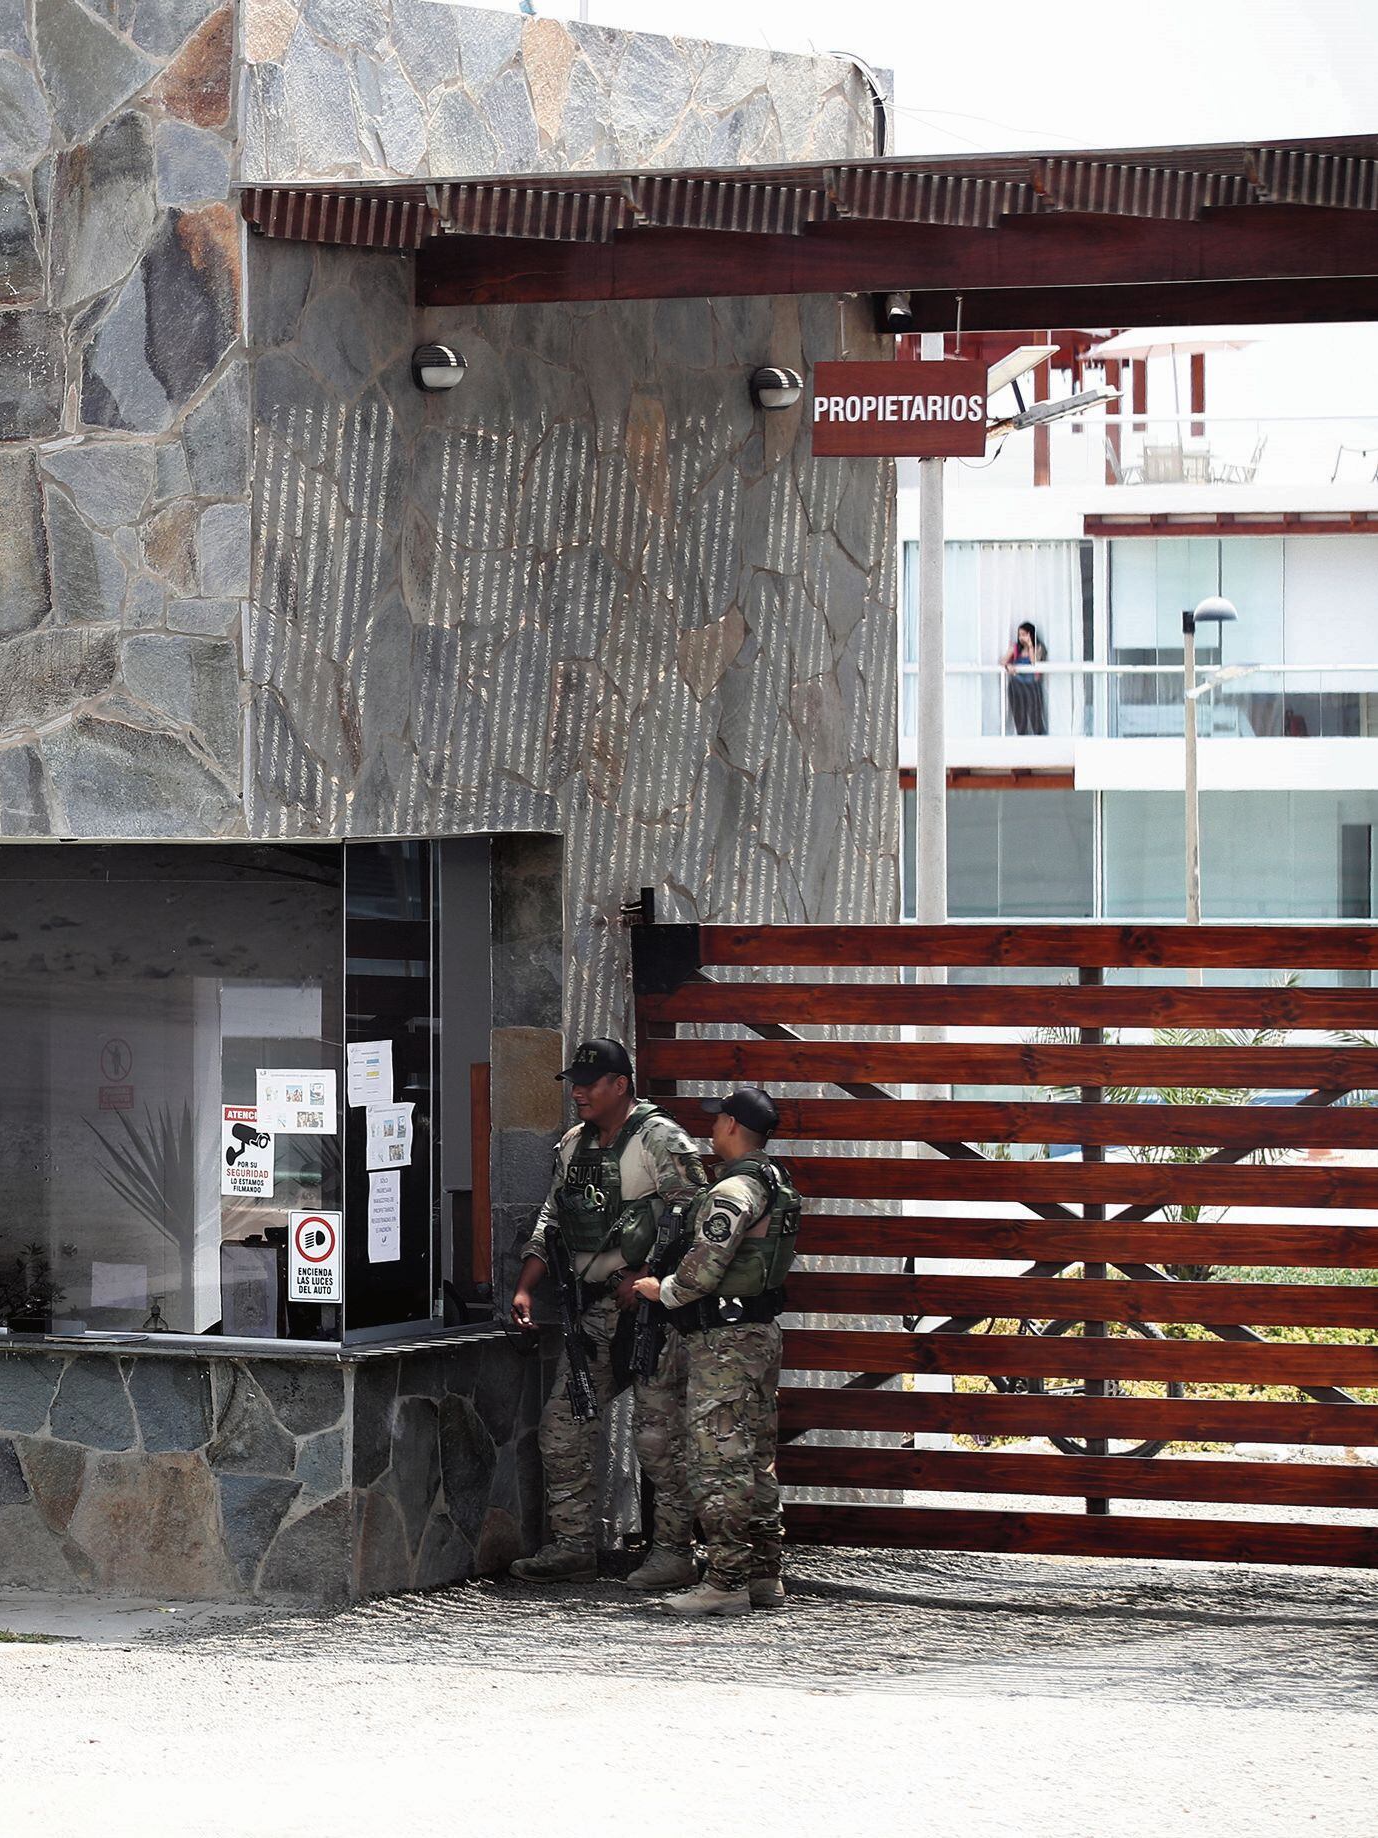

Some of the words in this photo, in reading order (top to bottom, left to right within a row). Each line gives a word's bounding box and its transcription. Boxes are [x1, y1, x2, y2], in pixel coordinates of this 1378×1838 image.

[813, 395, 983, 422] PROPIETARIOS
[227, 1110, 257, 1120] ATENCI
[226, 1168, 269, 1179] SEGURIDAD
[233, 1185, 262, 1194] FILMANDO
[297, 1267, 333, 1277] ENCIENDA
[296, 1277, 310, 1285] LAS
[311, 1277, 334, 1286] LUCES
[298, 1285, 312, 1294] DEL
[313, 1286, 332, 1295] AUTO
